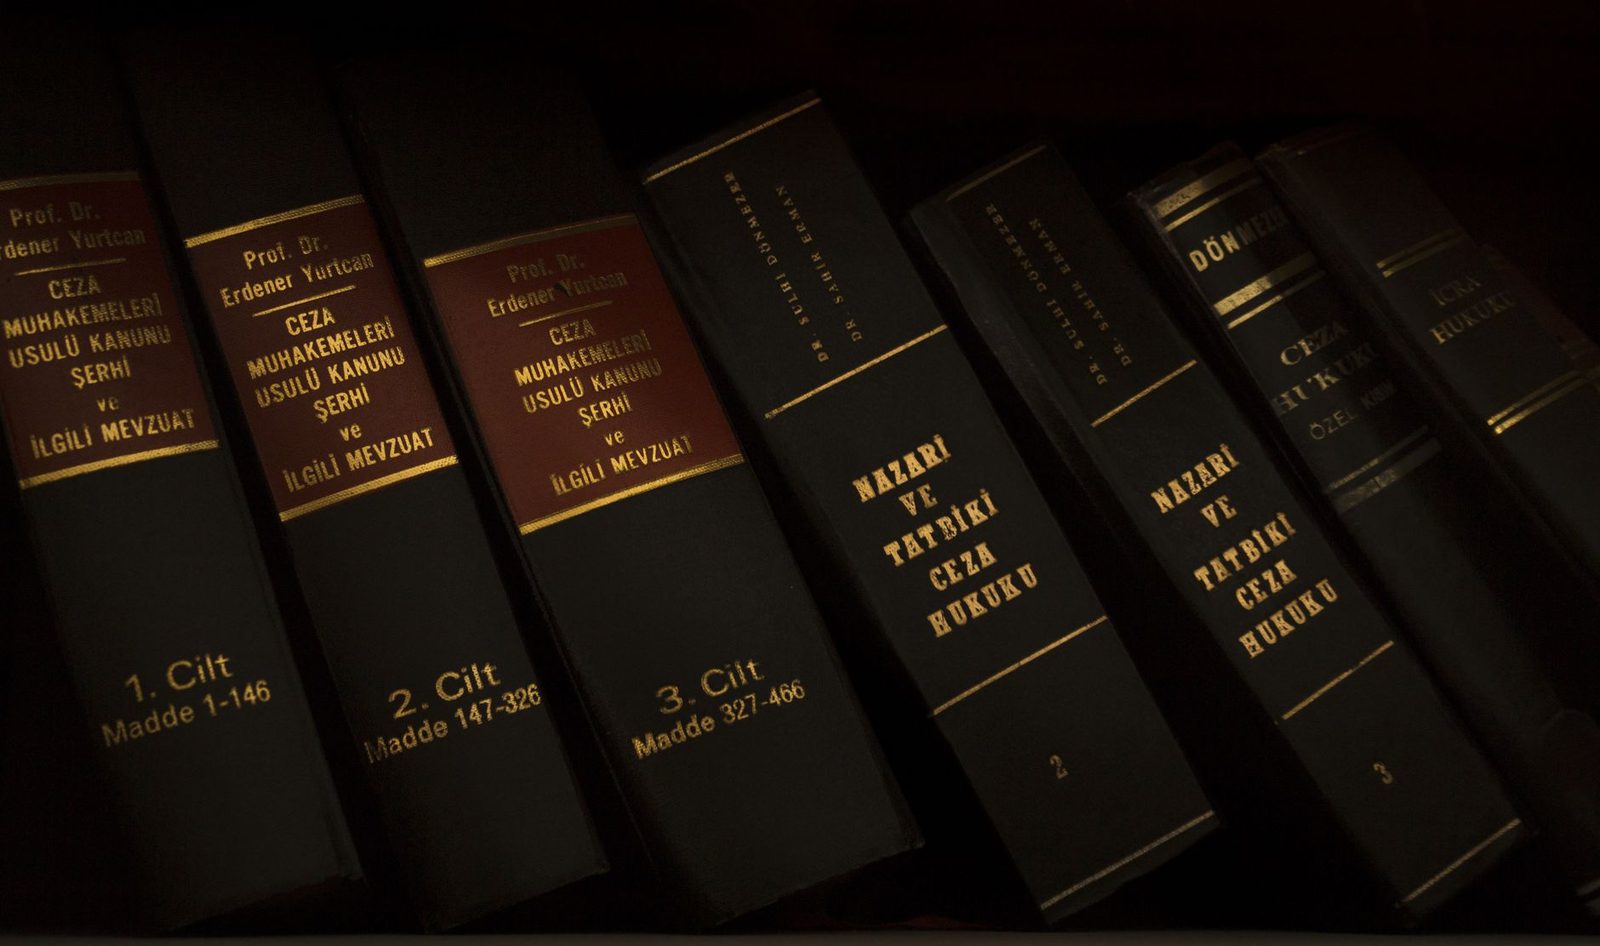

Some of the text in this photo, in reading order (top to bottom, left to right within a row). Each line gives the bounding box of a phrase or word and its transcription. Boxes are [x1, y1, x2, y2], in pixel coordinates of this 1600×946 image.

[9, 201, 101, 229] Prof. Dr.
[775, 185, 813, 245] ERMAN
[0, 228, 146, 261] dener Yurtcan
[243, 233, 329, 270] Prof. Dr.
[506, 253, 586, 284] Prof. Dr.
[1029, 218, 1072, 275] ERMAN
[48, 274, 101, 300] CEZA
[219, 251, 375, 308] Erdener Yurtcan
[487, 270, 629, 318] Erdener Yurtcan
[3, 292, 163, 339] MUHAKEMELERİ
[284, 306, 336, 337] CEZA
[548, 318, 597, 347] CEZA
[8, 325, 173, 368] USULÜ KANUNU
[246, 314, 395, 379] MUHAKEMELERİ
[513, 328, 653, 387] MUHAKEMELERİ
[1280, 320, 1350, 366] CEZA
[70, 356, 132, 389] ŞERHİ
[254, 345, 406, 408] USULÜ KANUNU
[522, 357, 663, 415] USULÜ KANUNU
[96, 395, 120, 412] ve
[313, 382, 371, 424] ŞERHİ
[578, 390, 633, 429] ŞERHİ
[1310, 408, 1358, 440] ÖZEL
[30, 408, 196, 460] İLGİLİ MEVZUAT
[339, 422, 362, 442] ve
[604, 428, 625, 447] ve
[281, 425, 434, 493] İLGİLİ MEVZUAT
[549, 434, 694, 497] İLGİLİ MEVZUAT
[852, 433, 952, 503] NAZARİ
[898, 483, 938, 517] VE
[1200, 494, 1238, 528] VE
[883, 488, 1000, 567] TATBİKİ
[928, 541, 998, 592] CEZA
[1235, 559, 1297, 611] CEZA
[927, 562, 1039, 638] HUKUKU
[1238, 578, 1338, 659] HUKUKU
[124, 652, 235, 703] 1. Cilt
[387, 660, 501, 720] 2. Cilt
[655, 658, 765, 715] 3. Cilt
[100, 679, 272, 748] Madde 1-146
[363, 682, 542, 765] Madde 147-326
[631, 678, 806, 760] Madde 327-466
[1049, 754, 1070, 780] 2
[1373, 760, 1393, 785] 3
